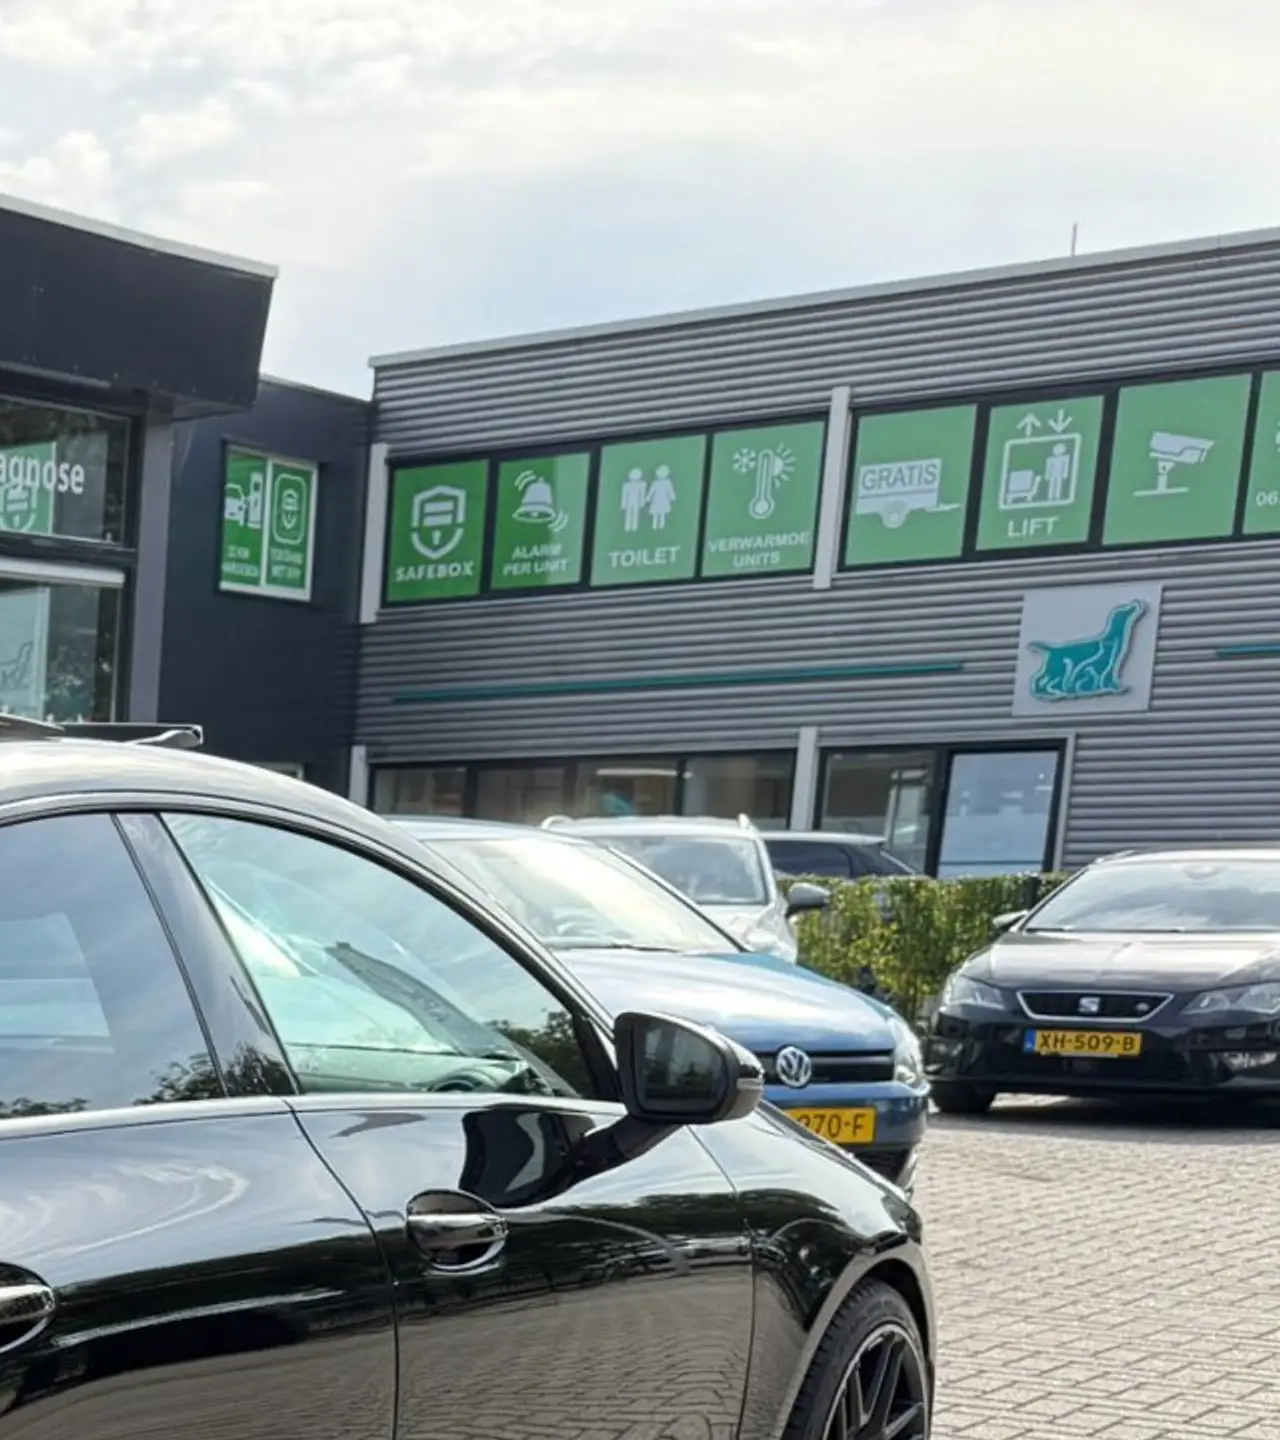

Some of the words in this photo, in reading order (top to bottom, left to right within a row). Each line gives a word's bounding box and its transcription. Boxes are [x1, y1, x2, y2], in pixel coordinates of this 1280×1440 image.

[862, 463, 937, 490] GRATIS
[1256, 490, 1280, 507] 06
[1007, 516, 1059, 537] LIFT
[708, 531, 810, 553] VERWARMDE
[608, 545, 681, 567] TOILET
[733, 551, 780, 567] UNITS
[395, 560, 474, 582] SAFEBOX
[503, 561, 531, 576] PER
[1040, 1032, 1136, 1051] XH-509-B
